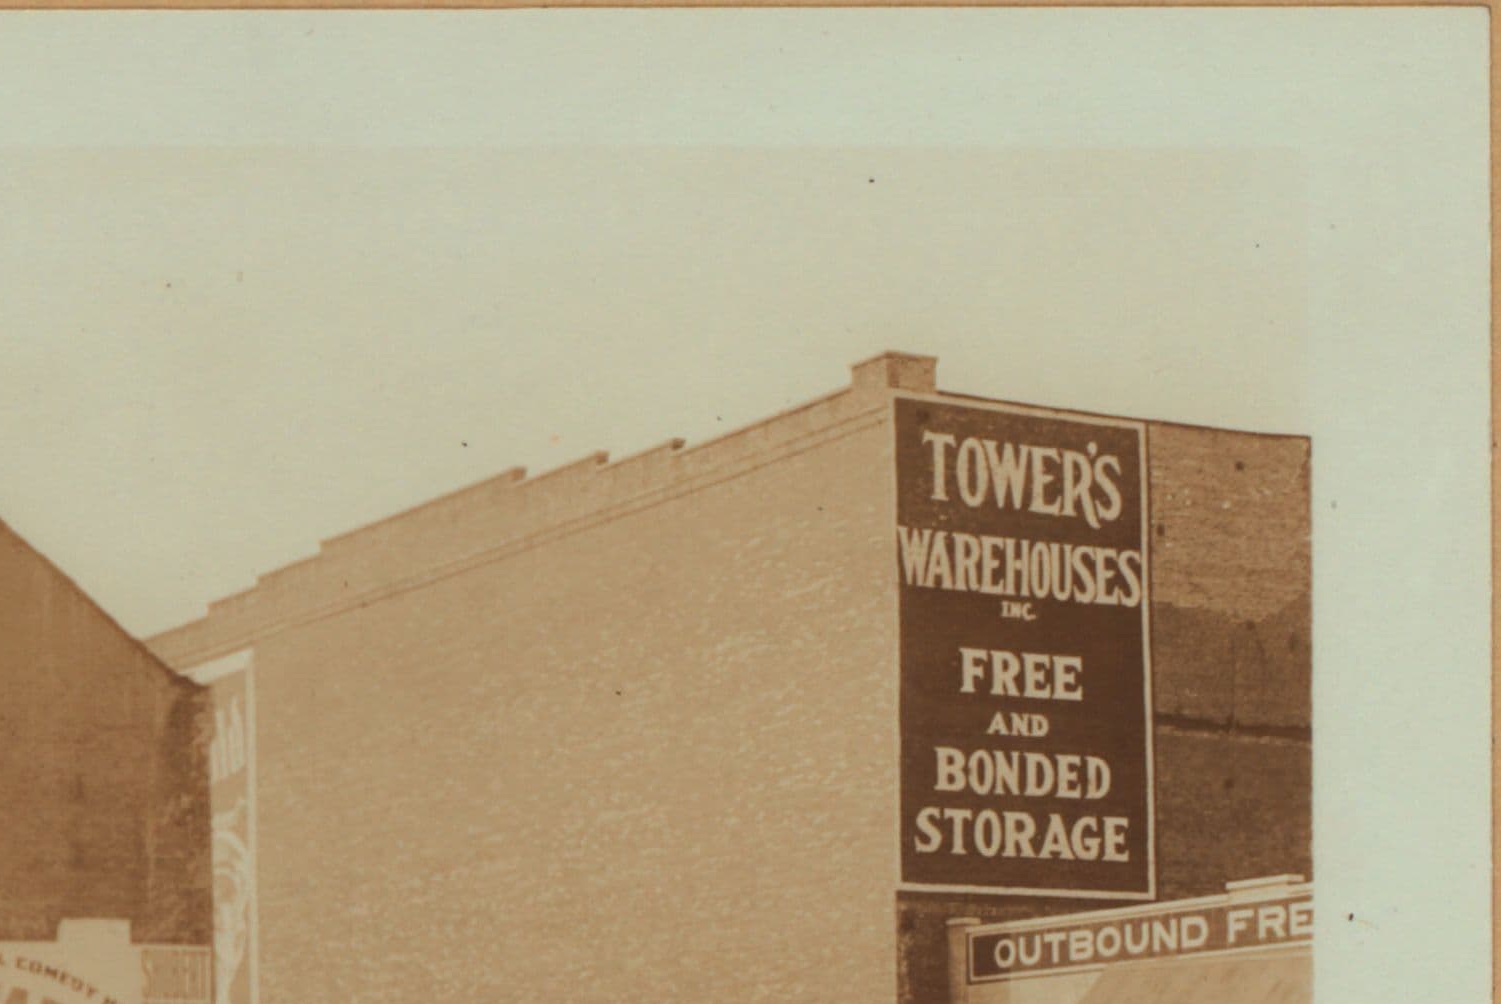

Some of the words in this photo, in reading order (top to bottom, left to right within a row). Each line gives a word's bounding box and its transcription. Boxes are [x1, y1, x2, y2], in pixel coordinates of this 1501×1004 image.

[922, 430, 1122, 529] TOWER'S
[898, 525, 1142, 608] WAREHOUSES
[959, 647, 1083, 701] FREE
[987, 712, 1049, 737] AND
[934, 747, 1112, 800] BONDED
[915, 807, 1129, 863] STORAGE
[995, 916, 1210, 969] OUTBOUND
[1226, 901, 1314, 943] FRE
[15, 956, 98, 998] COMEDY
